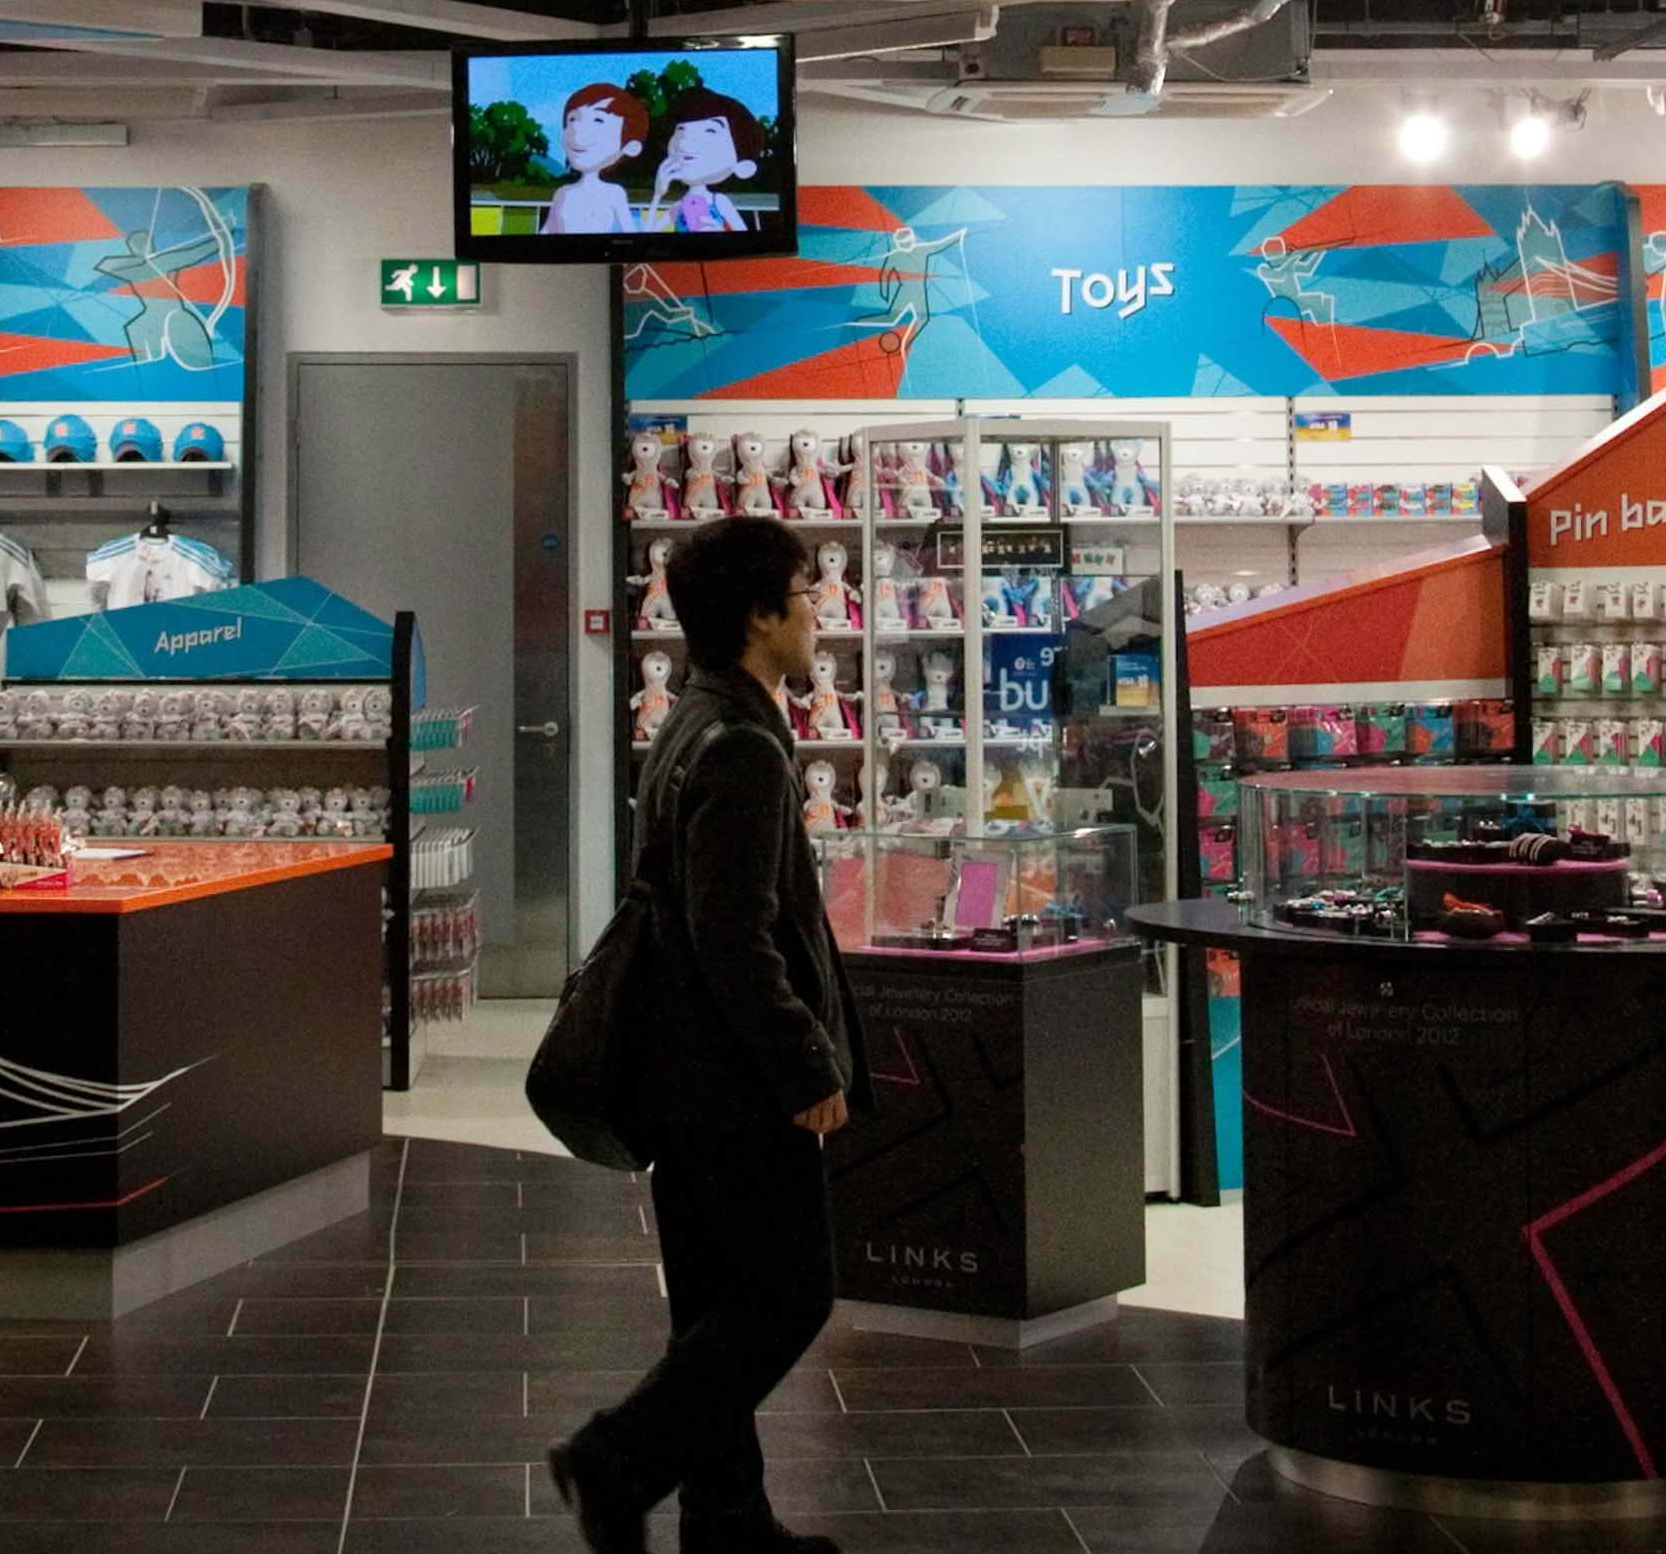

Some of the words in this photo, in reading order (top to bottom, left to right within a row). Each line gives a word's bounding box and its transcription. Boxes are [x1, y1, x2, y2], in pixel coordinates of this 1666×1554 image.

[1050, 261, 1176, 319] Toys
[1549, 502, 1609, 547] Pin
[154, 616, 244, 658] Apparel
[1420, 1003, 1518, 1025] Collection
[1416, 1027, 1460, 1046] 2012
[865, 1240, 980, 1275] LINKS
[1327, 1383, 1473, 1426] LINKS
